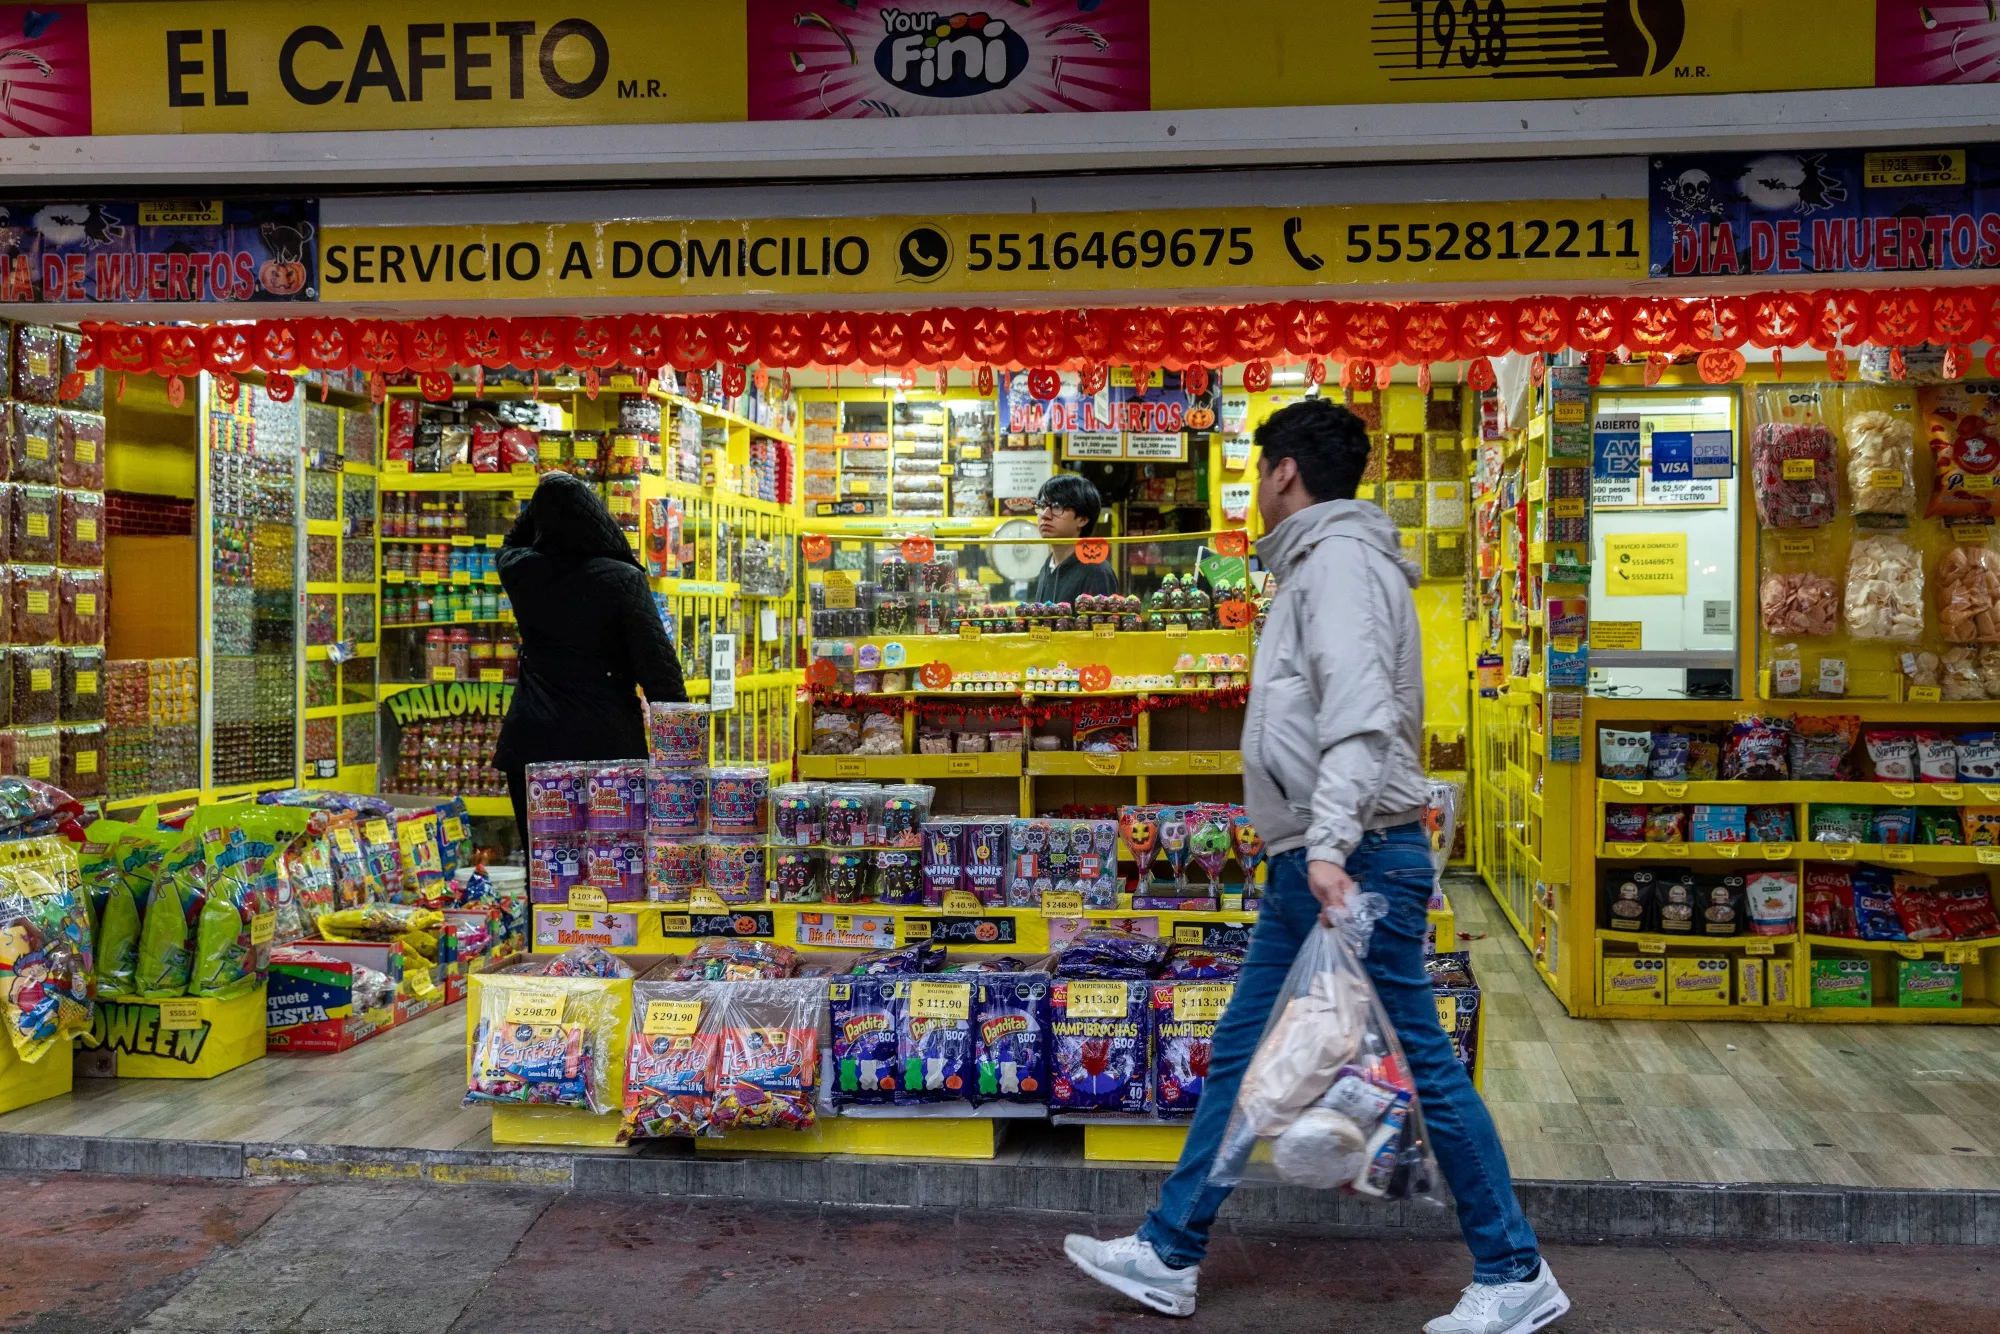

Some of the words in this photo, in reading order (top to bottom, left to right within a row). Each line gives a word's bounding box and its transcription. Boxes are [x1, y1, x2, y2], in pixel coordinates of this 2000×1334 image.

[1410, 0, 1508, 69] 1938
[1674, 65, 1710, 79] M.R.
[891, 20, 1007, 88] Fini
[166, 29, 249, 107] EL
[279, 18, 610, 105] CAFETO
[617, 80, 668, 99] M.R.
[1880, 159, 1908, 171] 1938
[1871, 174, 1888, 184] EL
[1892, 172, 1951, 183] CAFETO
[145, 213, 158, 222] EL
[162, 213, 212, 222] CAFETO
[1673, 220, 1739, 275] DIA
[1750, 219, 1801, 272] DE
[1812, 212, 2000, 270] MUERTOS
[325, 242, 541, 284] SERVICIO
[559, 242, 593, 280] A
[611, 235, 870, 279] DOMICILIO
[967, 227, 1255, 272] 5516469675
[1346, 219, 1641, 263] 5552812211
[0, 253, 34, 301] IA
[43, 254, 87, 300] DE
[96, 251, 255, 301] MUERTOS
[1010, 404, 1046, 433] DIA
[1052, 403, 1078, 431] DE
[1595, 421, 1640, 430] ABIERTO
[1602, 440, 1640, 458] AM
[1694, 445, 1729, 456] OPEN
[1608, 456, 1640, 473] EX
[1660, 462, 1689, 473] VISA
[1552, 615, 1584, 626] mentos
[1552, 659, 1585, 670] mentos
[388, 682, 516, 726] HALLOWEE
[924, 865, 961, 876] WINIS
[965, 865, 1002, 876] WINIS
[932, 876, 955, 885] VAMPIRO
[974, 877, 996, 885] VAMPIRO
[558, 929, 613, 945] Halloween
[809, 927, 825, 944] Día
[825, 928, 836, 944] de
[837, 929, 874, 947] Muertos
[835, 984, 846, 994] 22
[268, 992, 309, 1009] quete
[918, 999, 924, 1008] $
[927, 1000, 961, 1009] 111.90
[1075, 995, 1081, 1004] $
[1084, 995, 1119, 1004] 113.30
[1181, 999, 1186, 1007] $
[1190, 998, 1226, 1007] 113.30
[515, 1008, 521, 1016] $
[523, 1008, 557, 1016] 298.70
[652, 1013, 658, 1021] $
[660, 1013, 693, 1022] 291.90
[1461, 1017, 1471, 1026] 73
[845, 1015, 890, 1041] Panditas
[911, 1017, 955, 1038] Panditas
[984, 1018, 1026, 1043] Panditas
[1052, 1022, 1138, 1037] VAMPIBROCHAS
[1159, 1023, 1215, 1038] VAMPIBRO
[946, 1030, 964, 1041] BOO
[1017, 1033, 1036, 1044] BOO
[1114, 1038, 1134, 1049] BOO
[498, 1038, 567, 1068] Surtido
[637, 1050, 706, 1083] Surtido
[555, 1068, 562, 1079] Kg
[696, 1082, 702, 1093] Kg
[792, 1077, 799, 1088] Kg
[1130, 1087, 1143, 1099] 40
